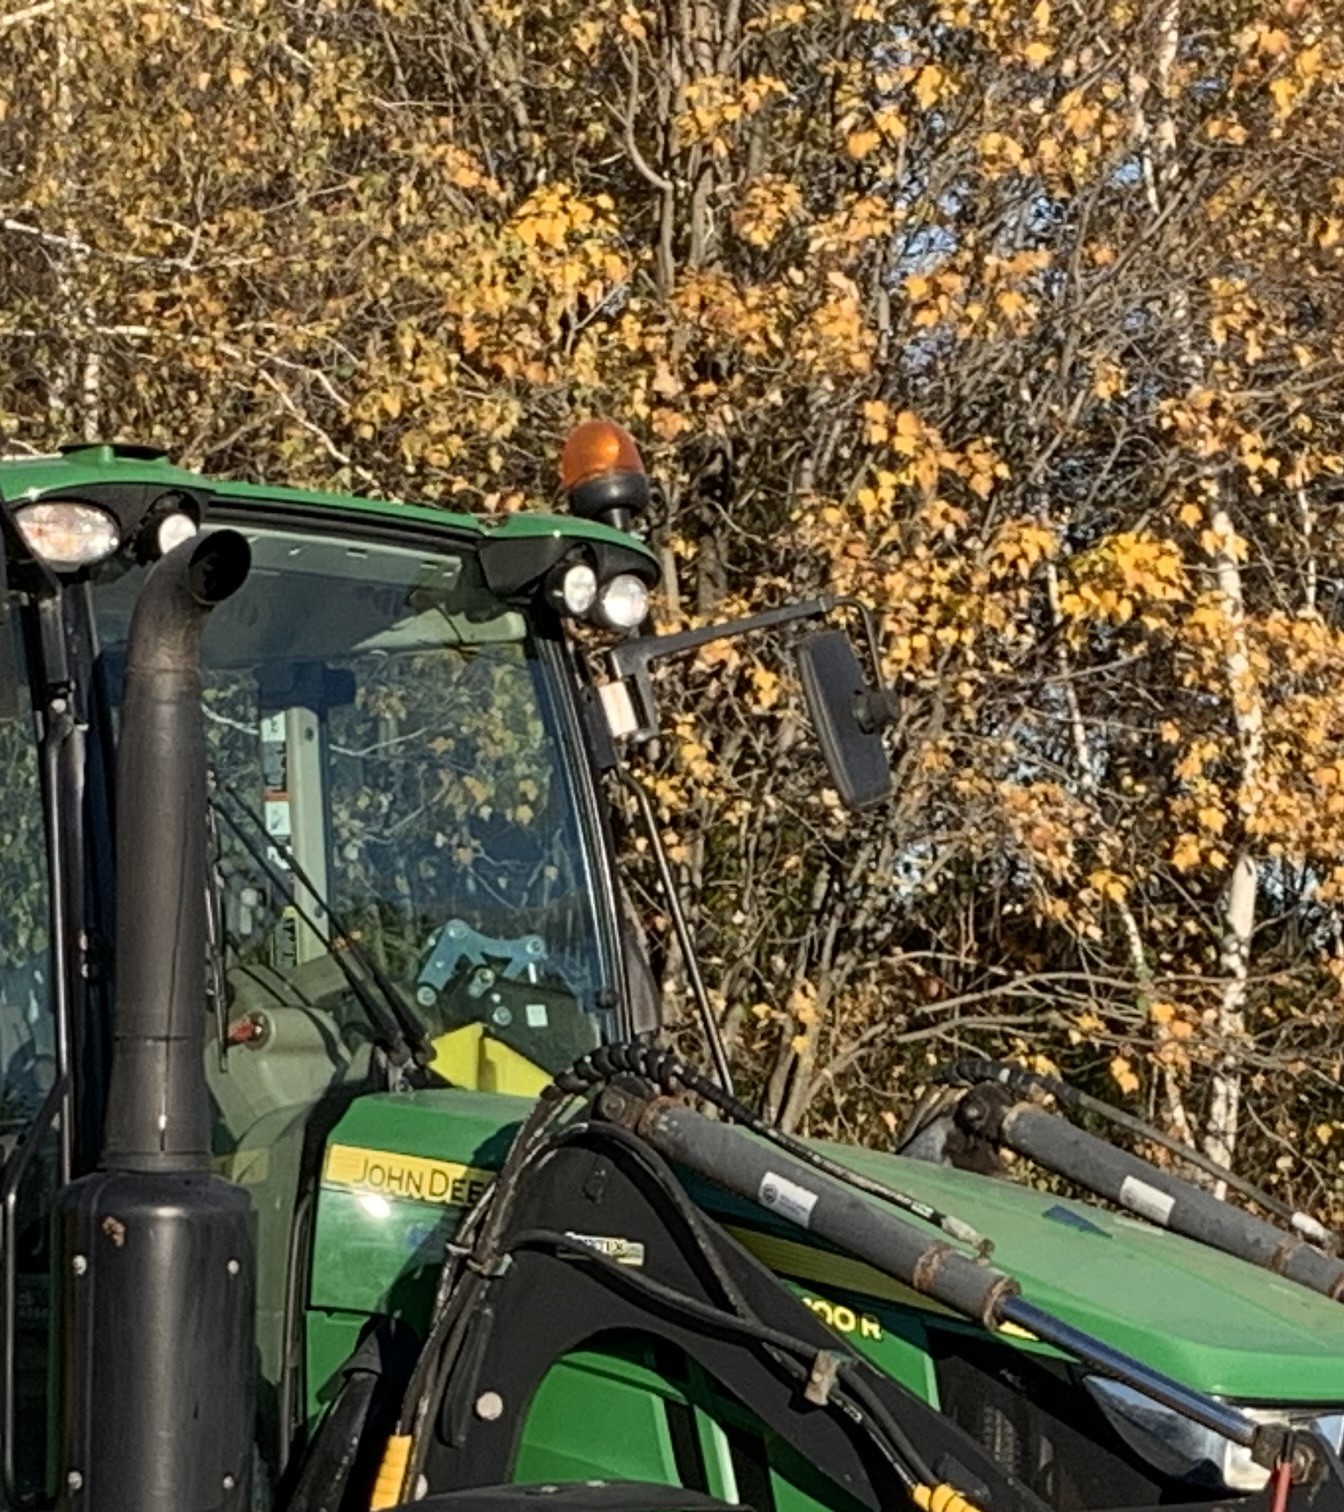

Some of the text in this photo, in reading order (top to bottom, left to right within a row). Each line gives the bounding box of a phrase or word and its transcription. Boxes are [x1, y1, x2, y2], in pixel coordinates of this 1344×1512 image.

[352, 1156, 485, 1203] JOHN DEE
[802, 1296, 882, 1340] 00R
